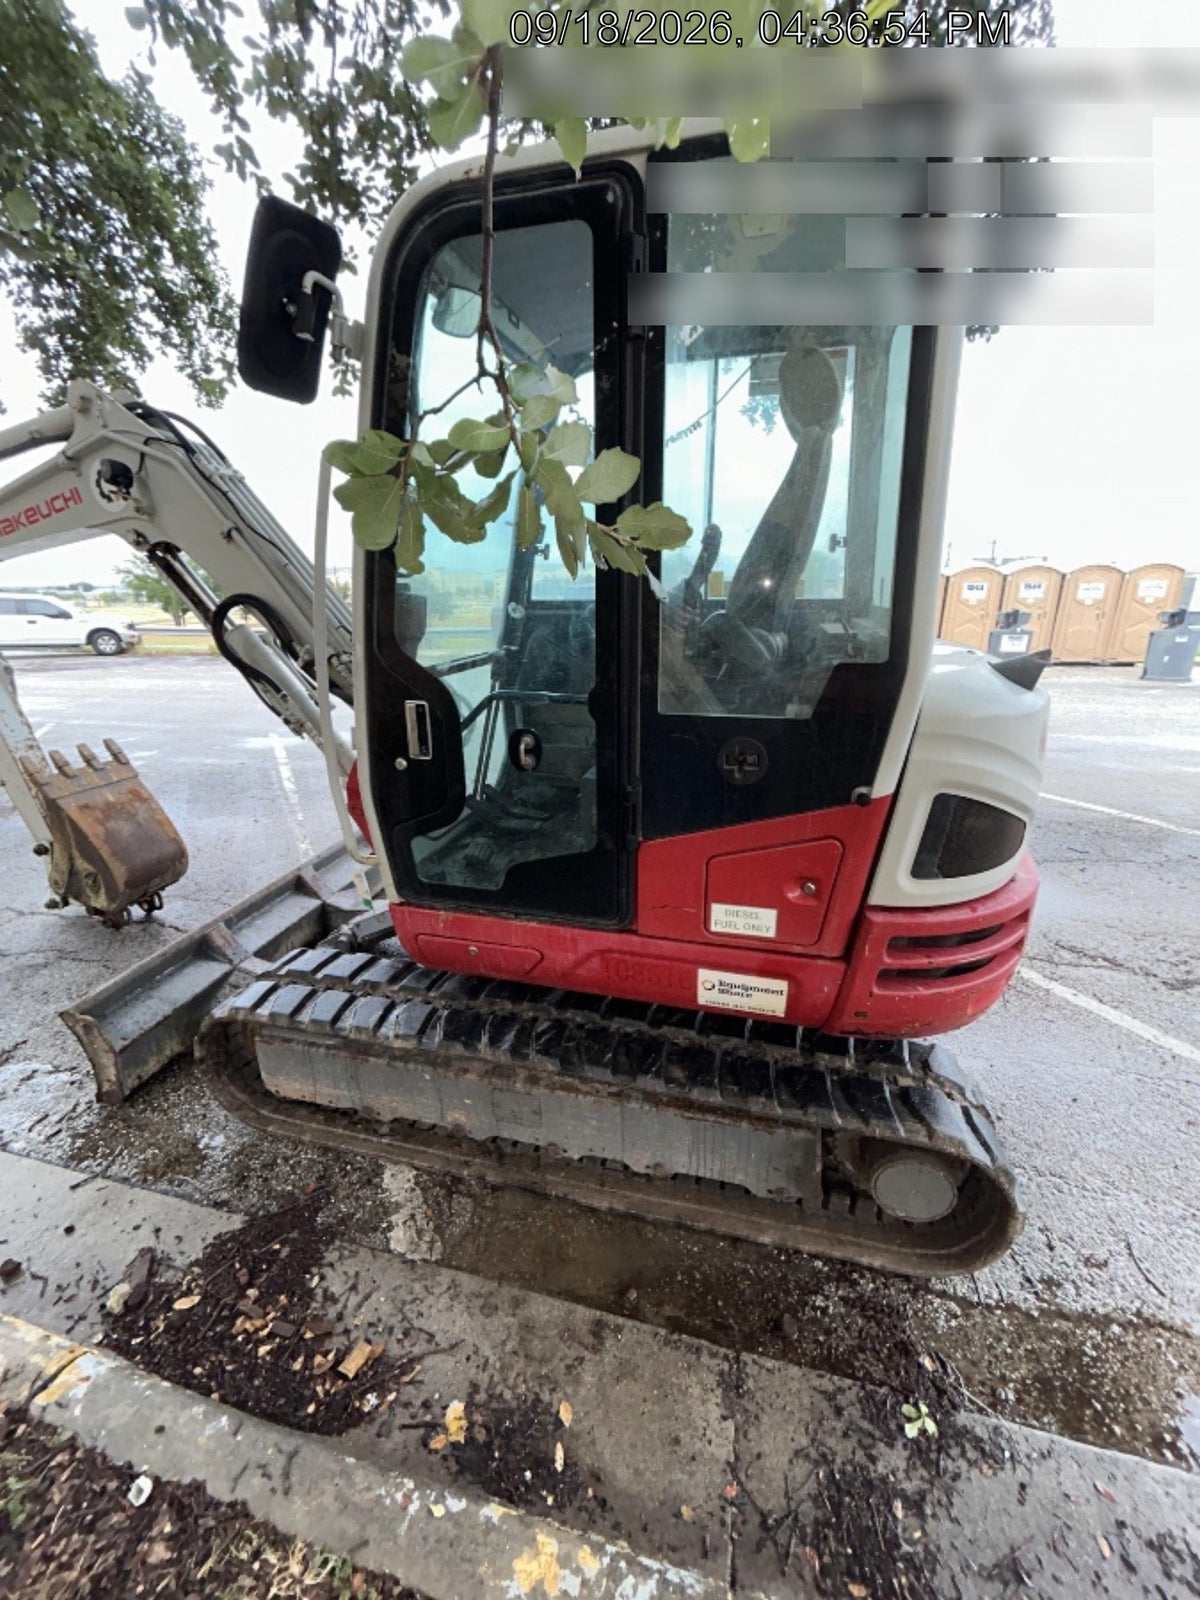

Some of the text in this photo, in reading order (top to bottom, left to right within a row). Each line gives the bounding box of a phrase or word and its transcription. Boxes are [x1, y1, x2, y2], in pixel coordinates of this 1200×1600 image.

[724, 908, 761, 920] DIESEL
[714, 919, 771, 934] FUEL ONLY
